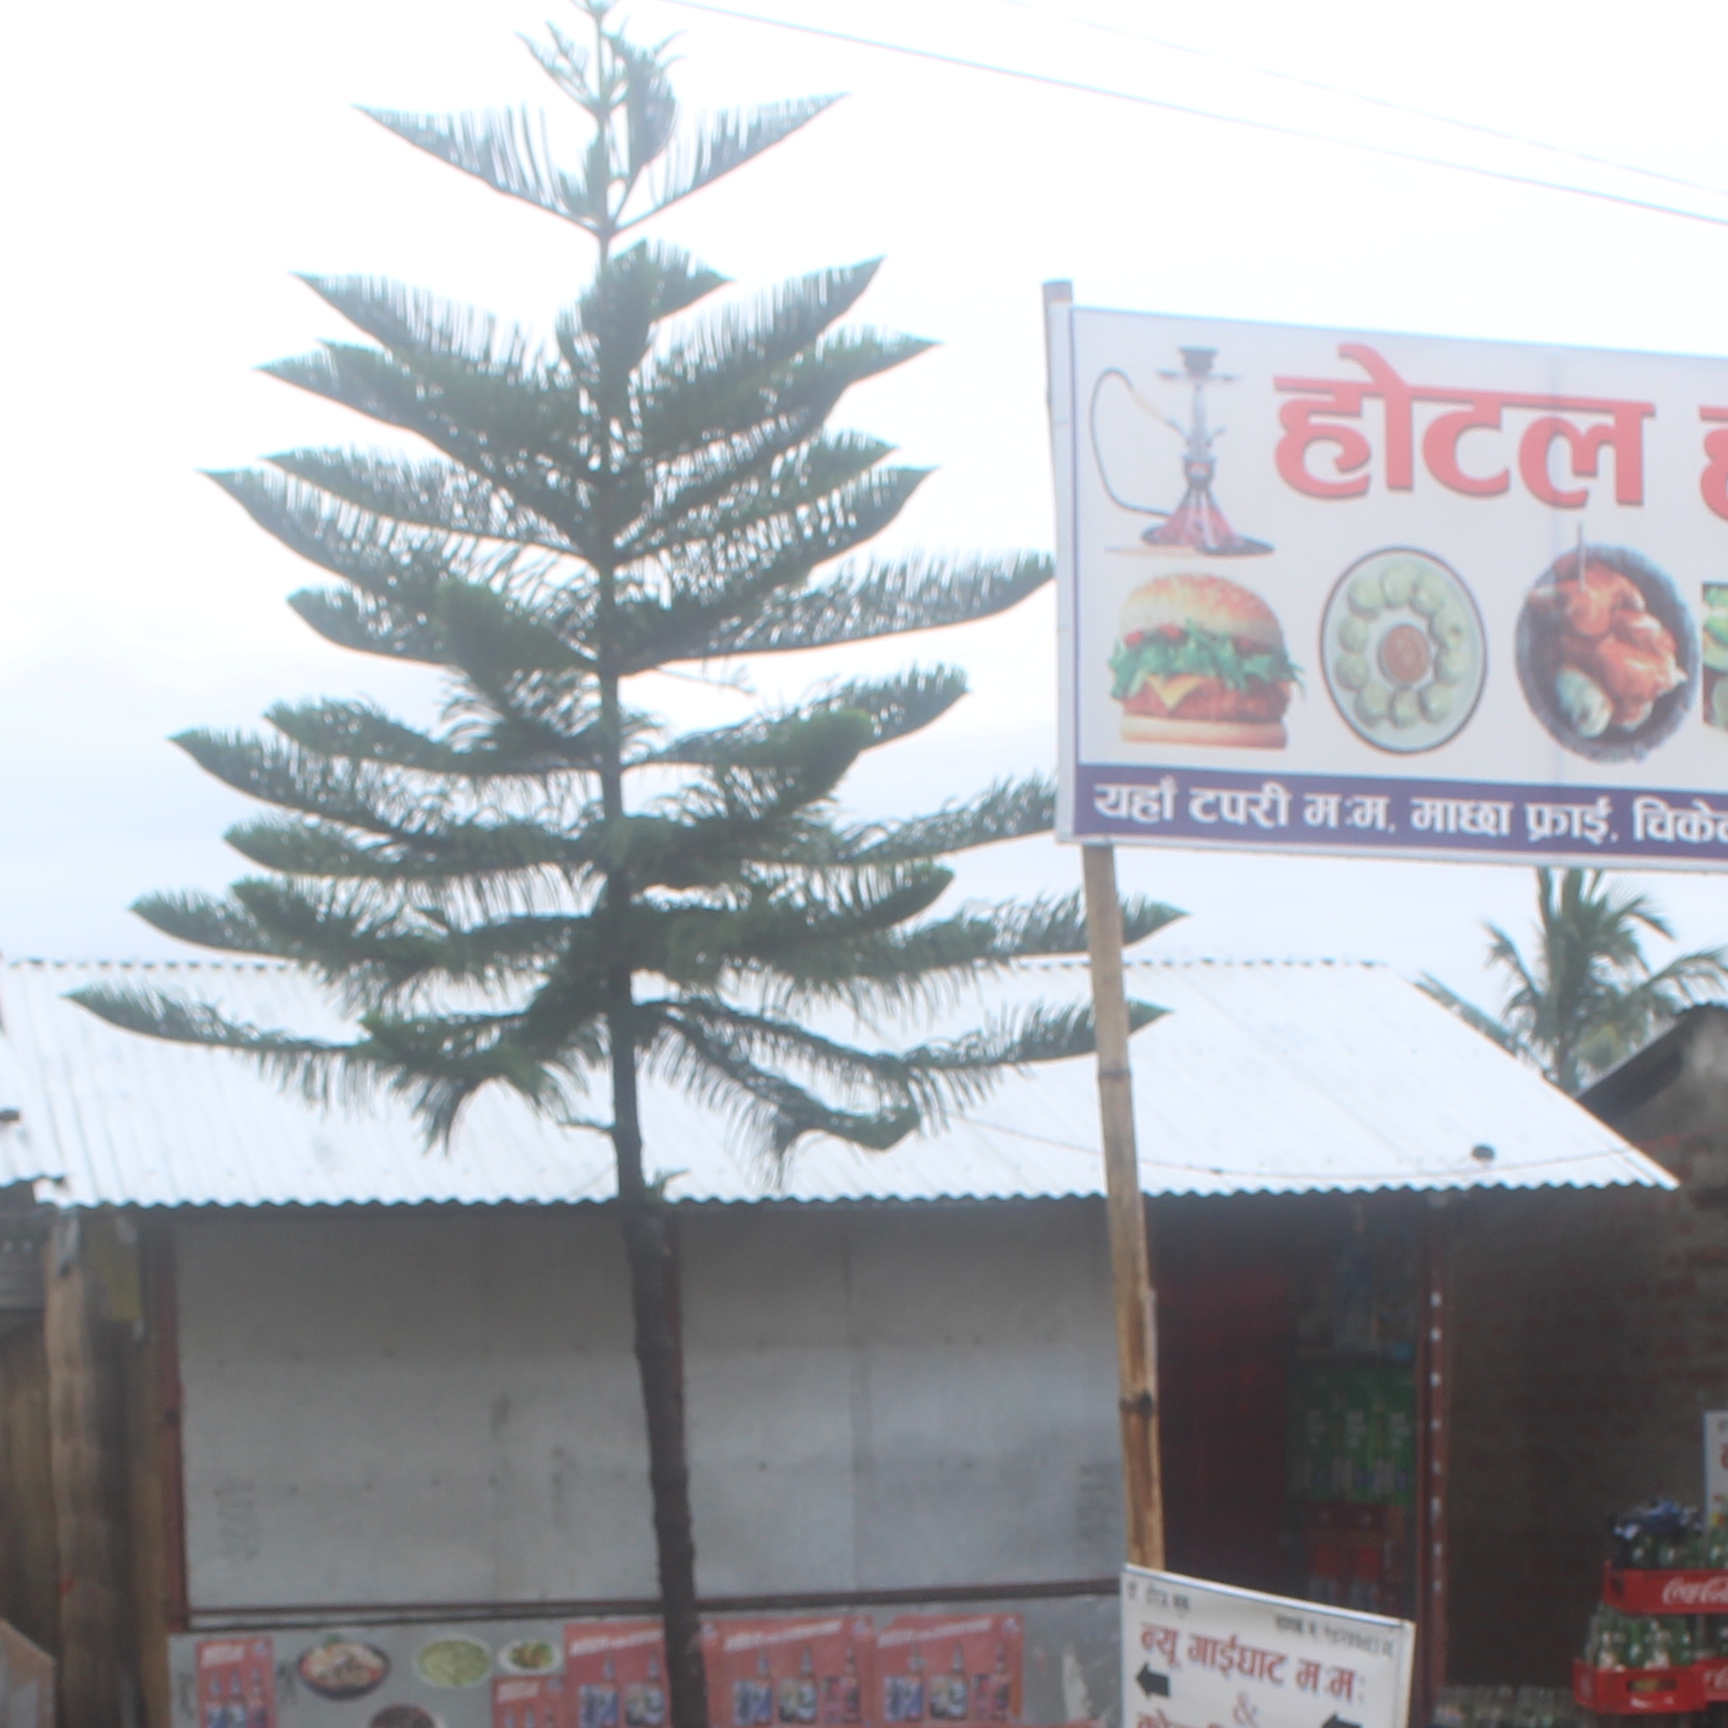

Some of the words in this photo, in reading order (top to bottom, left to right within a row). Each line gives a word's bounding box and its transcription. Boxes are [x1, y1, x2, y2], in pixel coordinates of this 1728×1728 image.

[1273, 342, 1656, 509] होटल
[1187, 781, 1293, 829] टपरी
[1410, 796, 1514, 837] माछा
[1140, 1620, 1181, 1669] न्यू
